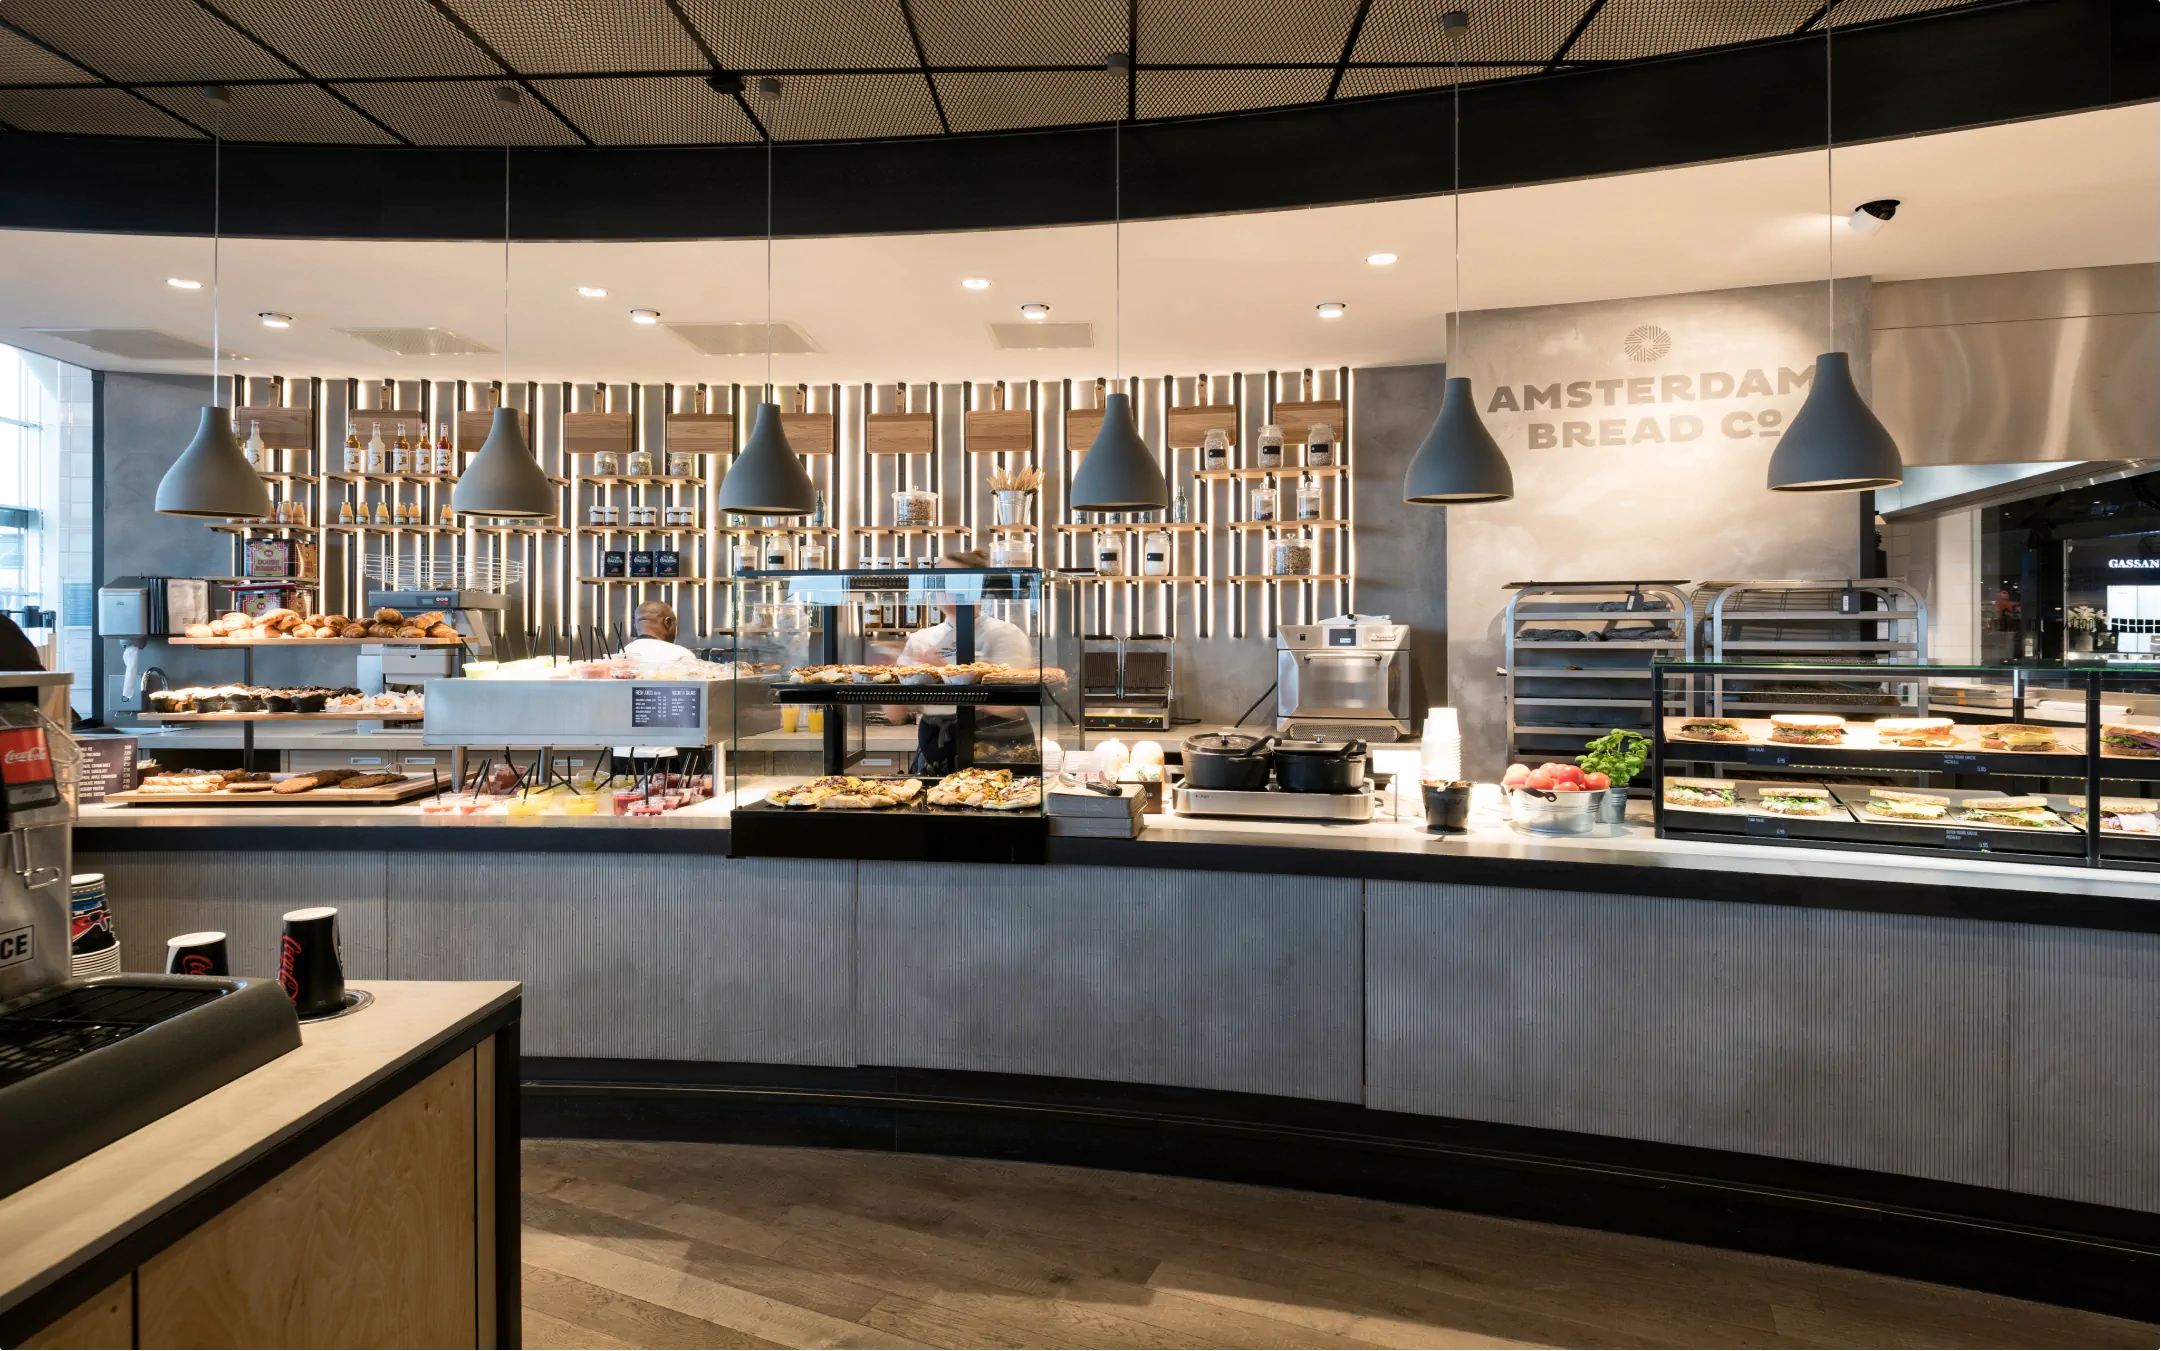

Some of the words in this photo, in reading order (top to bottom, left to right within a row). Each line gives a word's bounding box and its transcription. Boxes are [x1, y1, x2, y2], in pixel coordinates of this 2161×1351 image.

[1487, 364, 1817, 413] AMSTERDAM
[1528, 413, 1704, 450] BREAD
[2108, 558, 2160, 569] GASSAN
